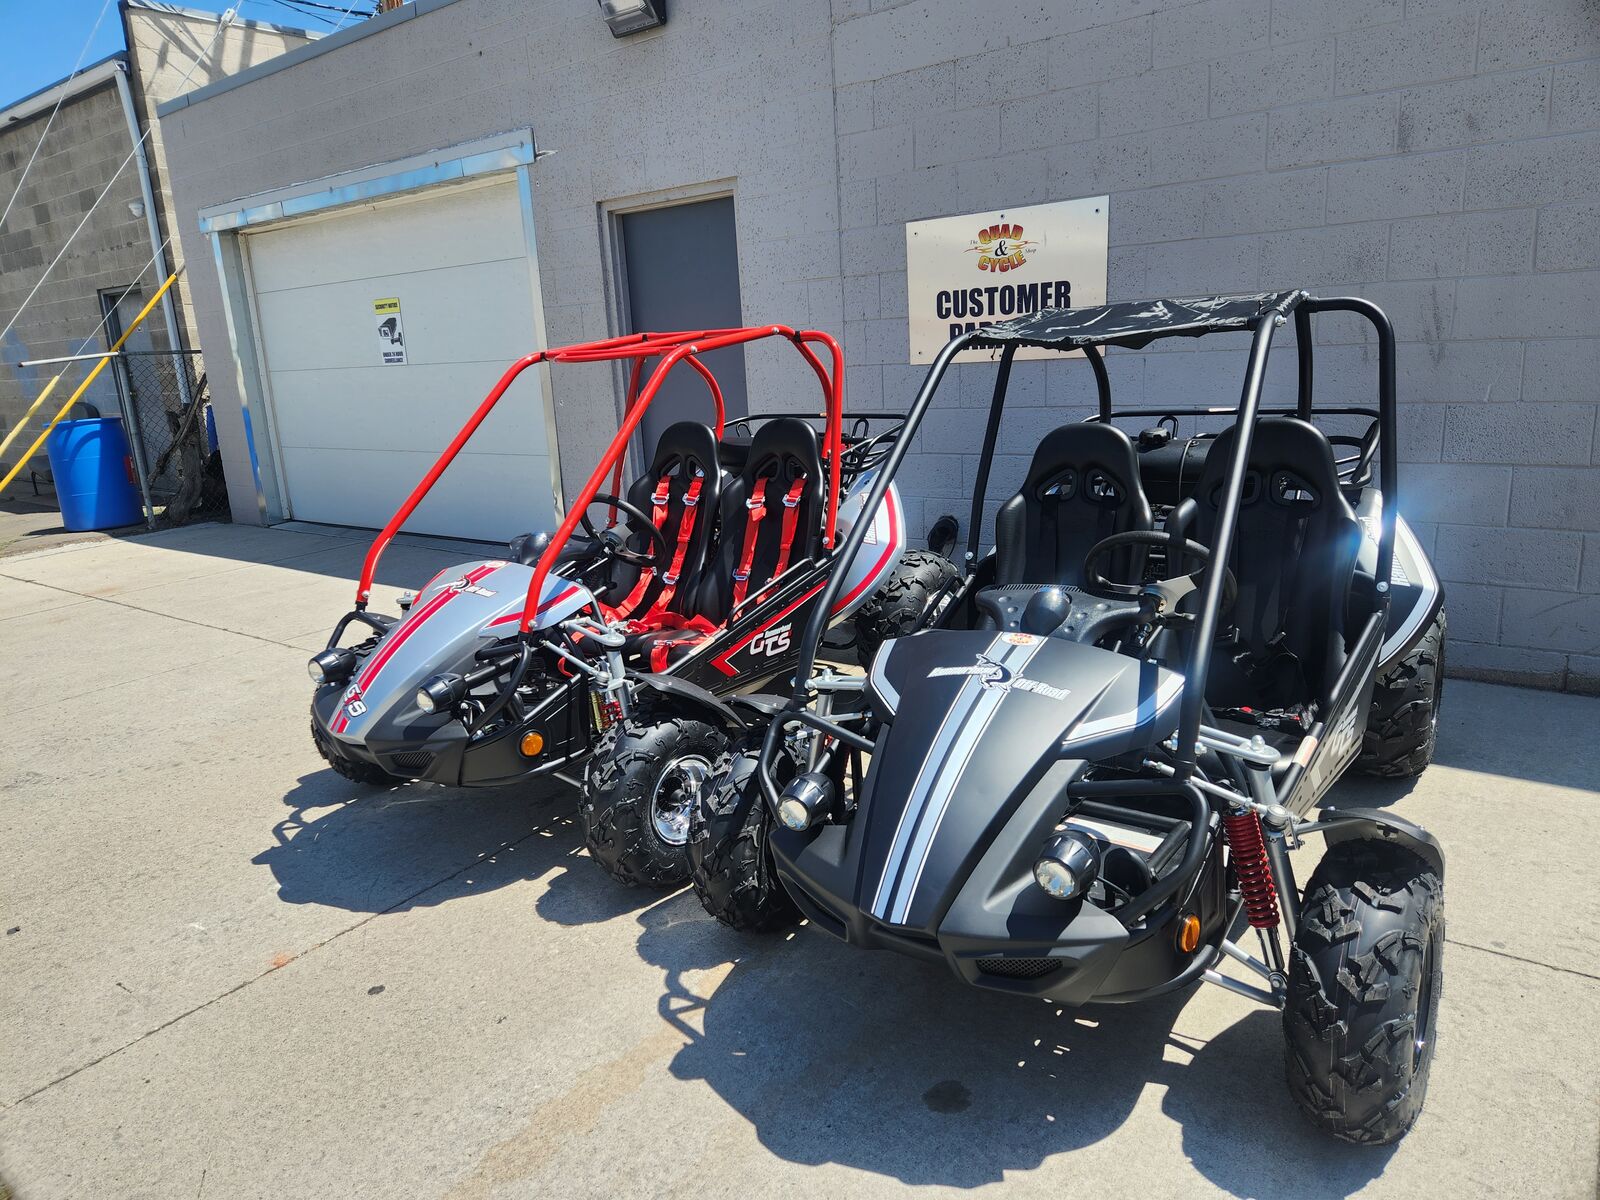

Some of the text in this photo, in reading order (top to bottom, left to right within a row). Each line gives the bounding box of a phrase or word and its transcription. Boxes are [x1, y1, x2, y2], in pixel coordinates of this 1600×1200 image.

[978, 224, 1023, 244] QUAD
[994, 240, 1008, 257] &
[977, 250, 1026, 272] CYCLE
[936, 280, 1071, 319] CUSTOMER
[749, 630, 792, 657] GTS
